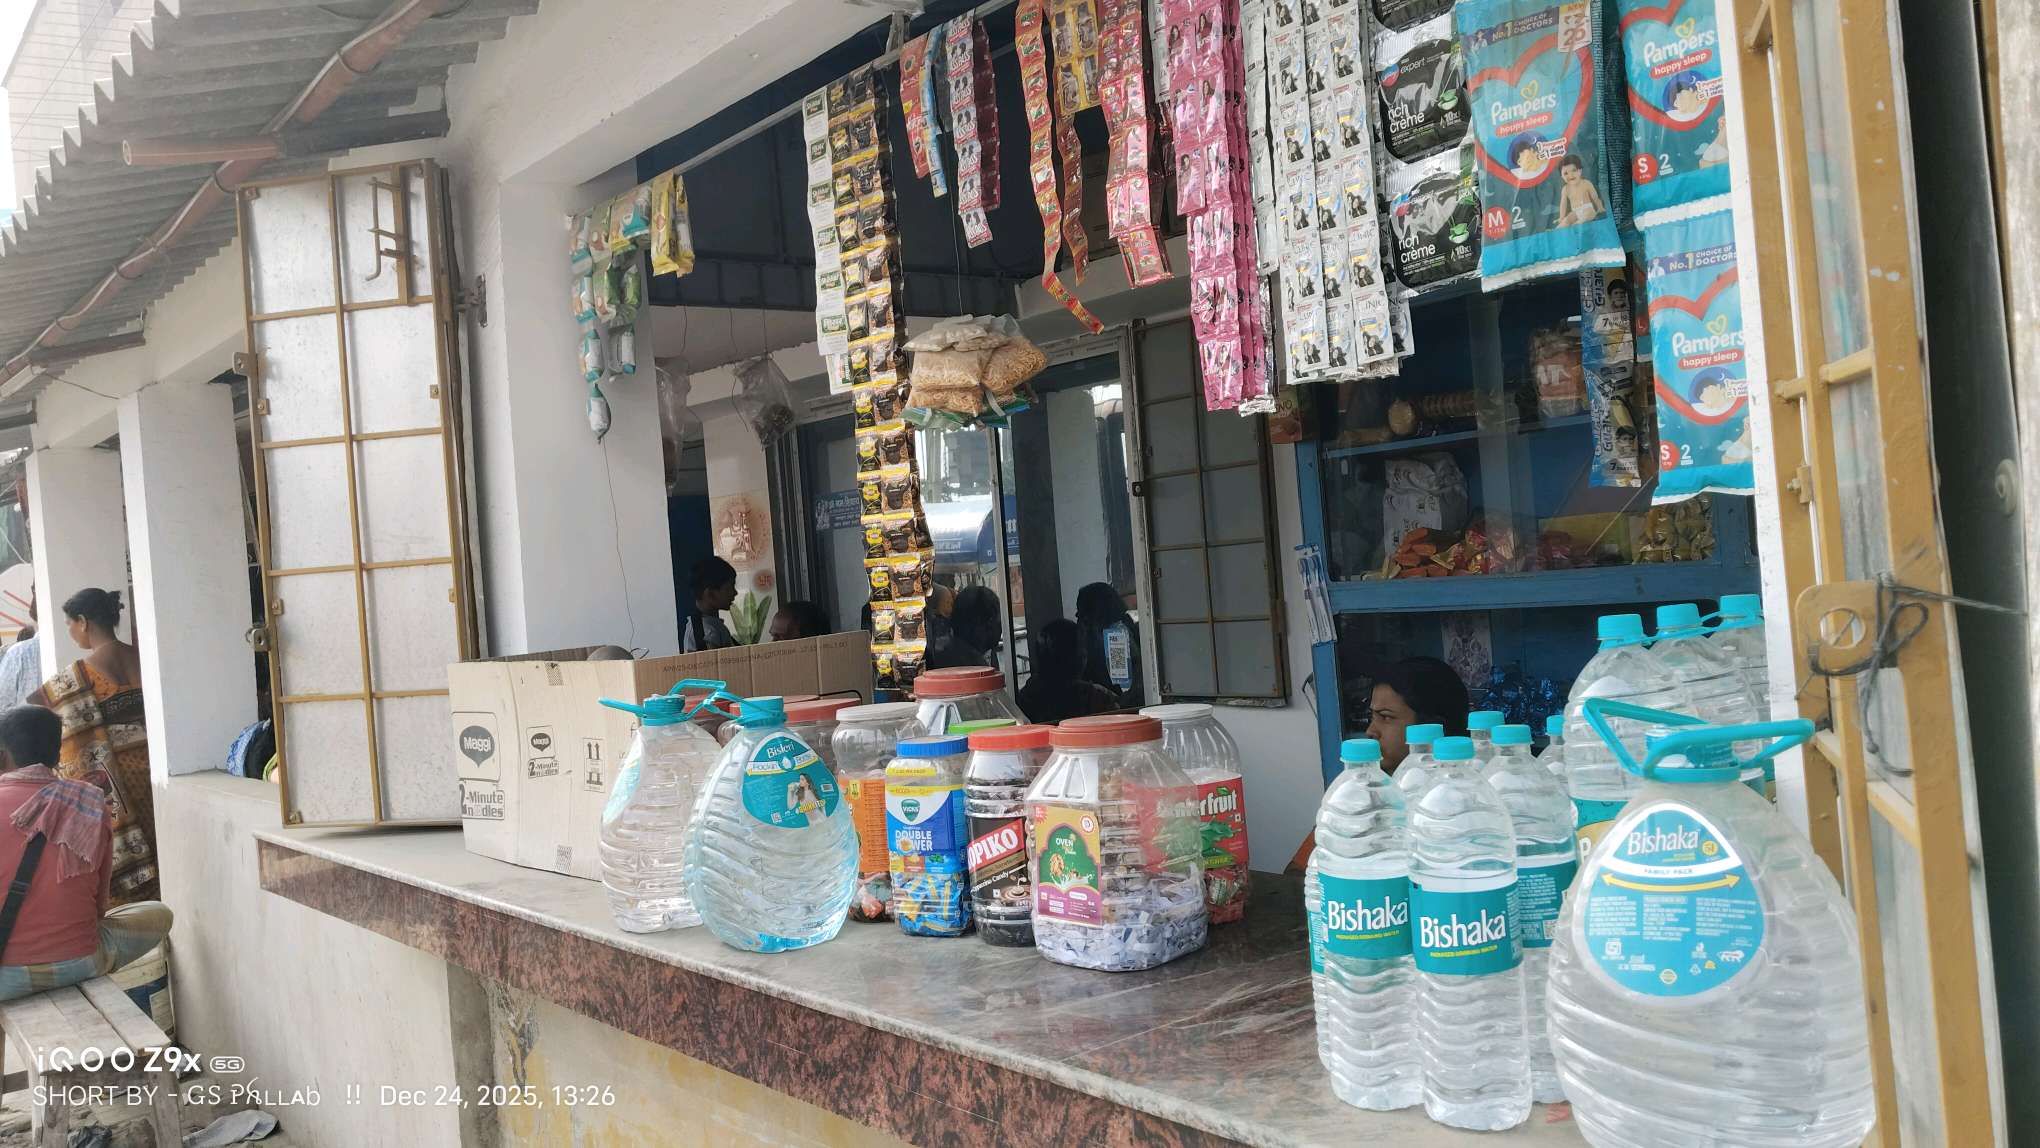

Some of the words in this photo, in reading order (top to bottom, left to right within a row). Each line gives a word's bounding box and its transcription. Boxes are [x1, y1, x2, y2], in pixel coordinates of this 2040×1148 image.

[1513, 17, 1554, 34] DOCTORS
[1643, 29, 1716, 68] Pampers
[1400, 57, 1425, 75] expert
[1654, 59, 1683, 76] happy
[1683, 51, 1707, 67] sleep
[1387, 102, 1409, 121] rich
[1491, 93, 1557, 126] Pampers
[1389, 112, 1425, 134] crème
[1499, 120, 1526, 135] happy
[1525, 114, 1549, 128] sleep
[1637, 156, 1649, 174] S
[1658, 153, 1672, 169] 2
[1487, 210, 1504, 228] M
[1511, 206, 1525, 224] 2
[1398, 233, 1420, 251] rich
[1400, 243, 1436, 264] crème
[1671, 330, 1745, 358] Pampers
[1683, 354, 1712, 368] happy
[1712, 350, 1738, 363] sleep
[1660, 444, 1671, 460] S
[1680, 444, 1692, 460] 2
[463, 735, 492, 752] Maggi
[532, 736, 550, 747] Maggi
[766, 741, 795, 759] Bisleri
[467, 803, 504, 818] ndles
[903, 805, 919, 813] VICKS
[896, 830, 933, 841] DOUBLE
[1055, 837, 1074, 847] OVEN
[1627, 824, 1699, 857] Bishaka
[967, 828, 1018, 869] OPIKO
[1327, 895, 1409, 932] Bishaka
[1419, 908, 1507, 949] Bishaka
